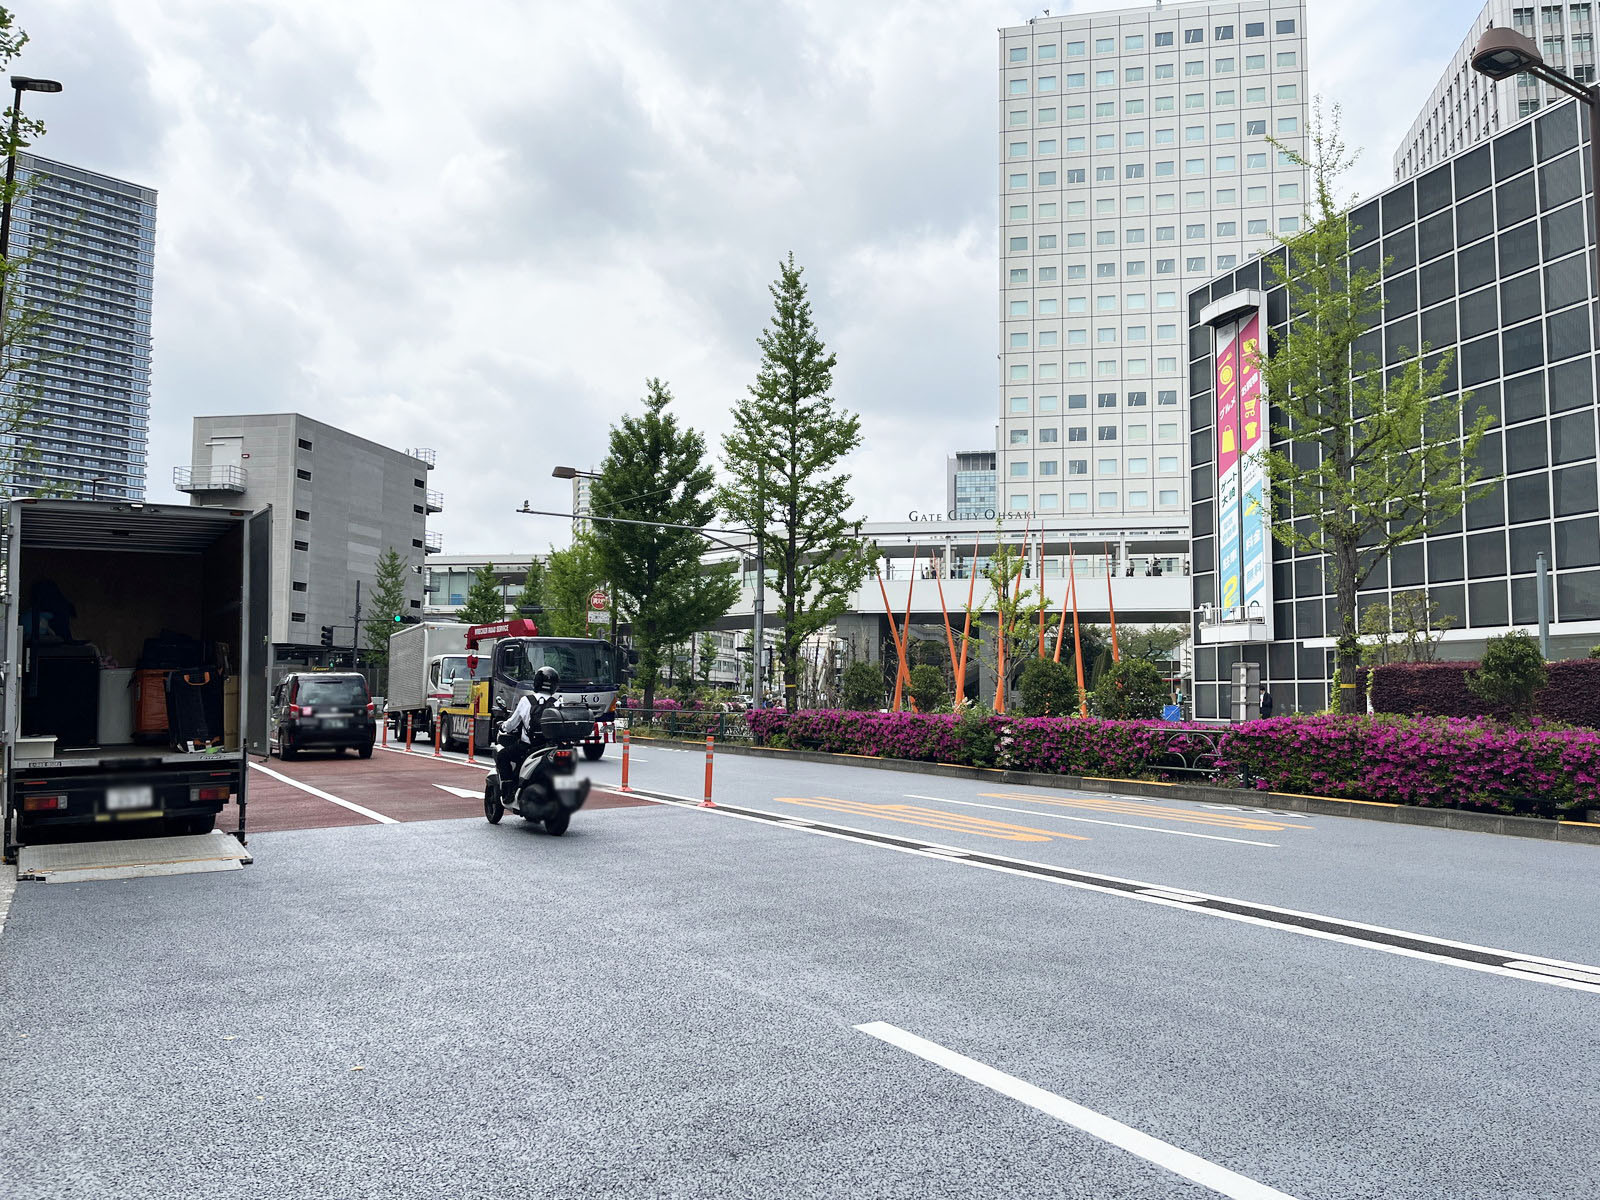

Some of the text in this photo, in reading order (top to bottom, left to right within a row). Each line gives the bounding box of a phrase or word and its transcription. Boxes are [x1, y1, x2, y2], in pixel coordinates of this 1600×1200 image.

[1220, 472, 1237, 494] ゲート
[908, 508, 1037, 522] GATE CITY OHSAKI
